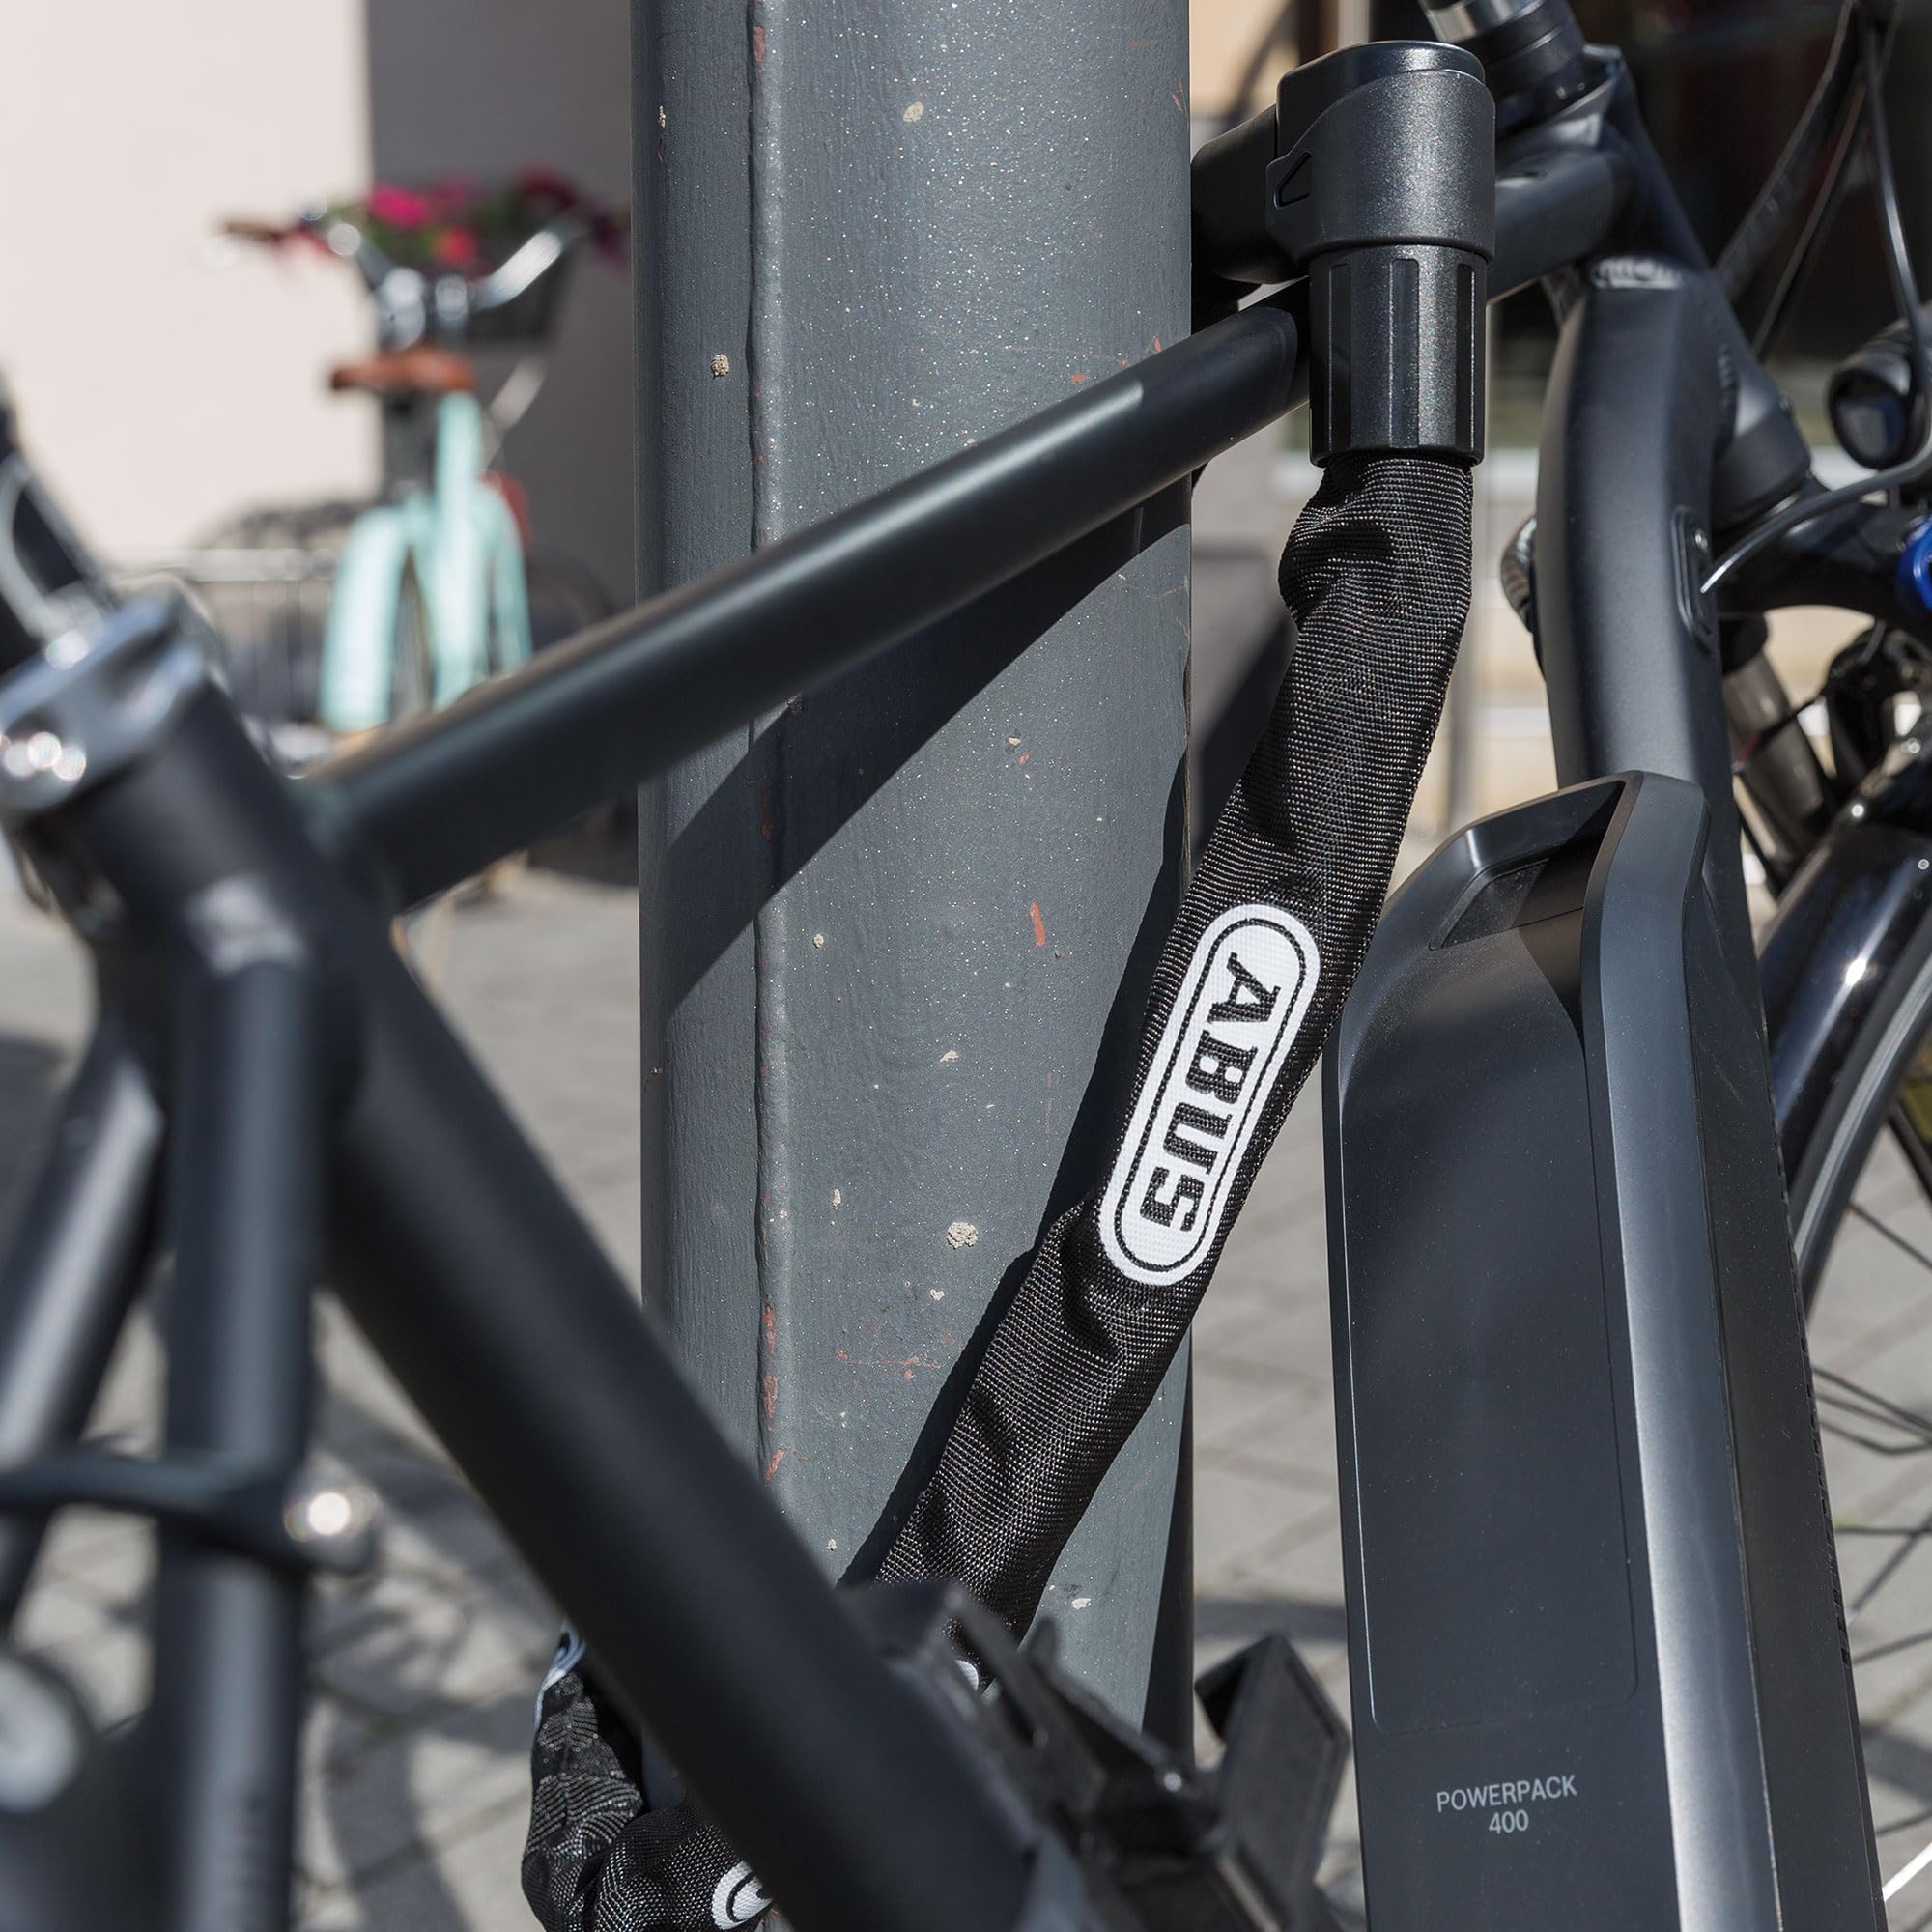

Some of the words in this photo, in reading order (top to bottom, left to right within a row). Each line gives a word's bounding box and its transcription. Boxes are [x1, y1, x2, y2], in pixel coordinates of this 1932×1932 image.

[1140, 952, 1281, 1233] ABUS
[1436, 1774, 1577, 1813] POWERPACK
[1488, 1809, 1529, 1834] 400
